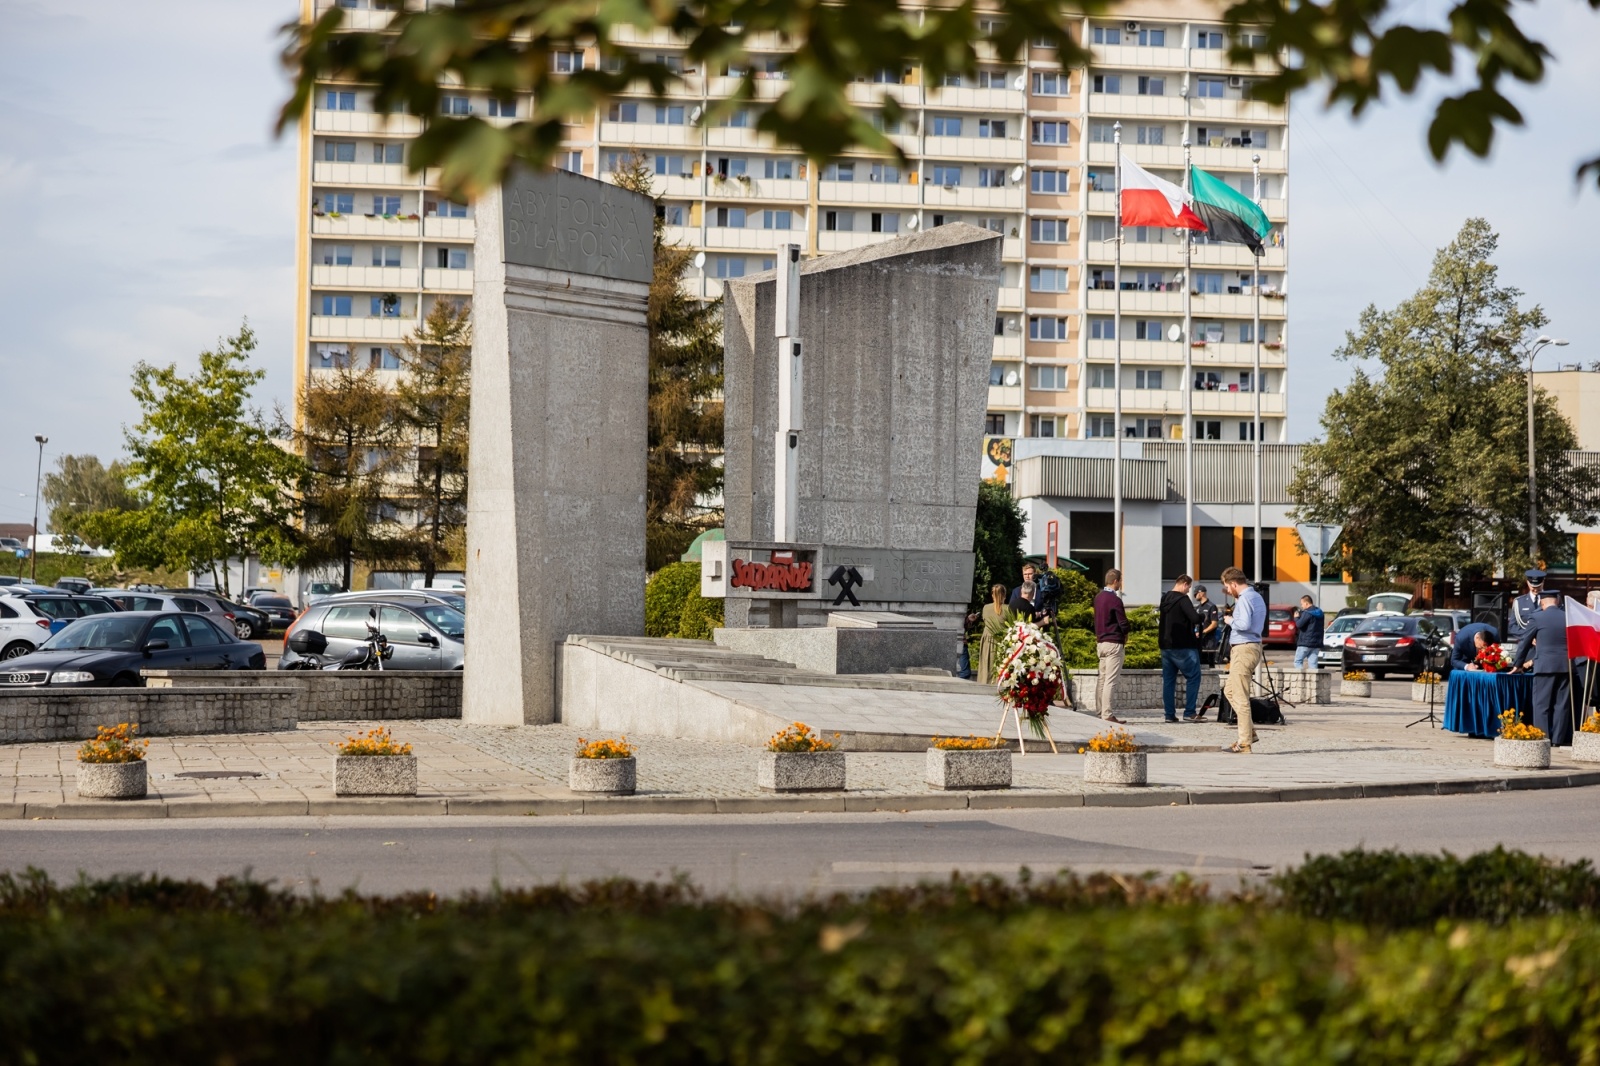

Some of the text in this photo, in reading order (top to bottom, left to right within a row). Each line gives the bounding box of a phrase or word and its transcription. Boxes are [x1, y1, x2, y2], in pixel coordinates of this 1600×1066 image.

[508, 187, 640, 235] ABY POLSKA
[567, 227, 649, 268] POLSKA
